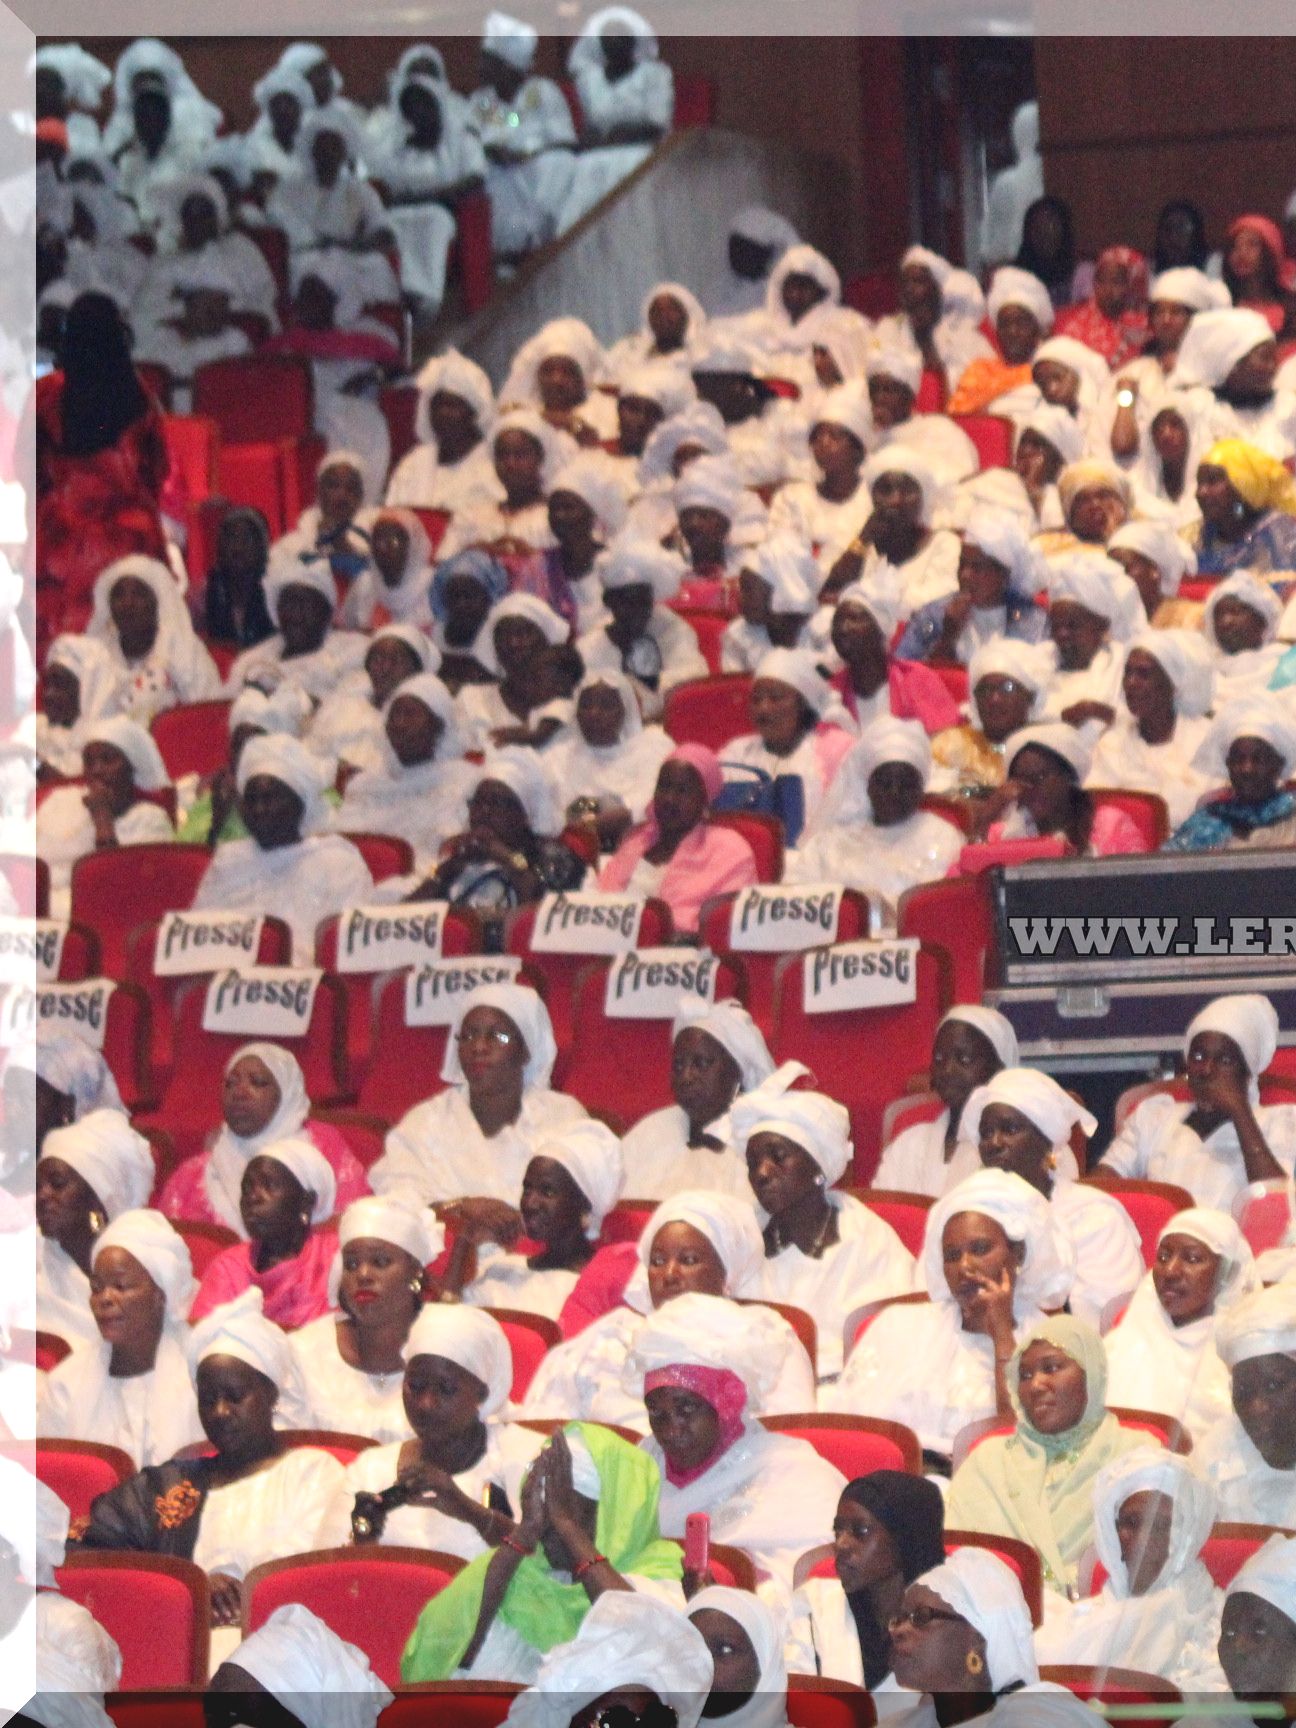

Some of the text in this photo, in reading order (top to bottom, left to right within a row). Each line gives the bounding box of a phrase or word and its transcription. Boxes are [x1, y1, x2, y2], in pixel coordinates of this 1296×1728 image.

[165, 907, 257, 959] Presse
[347, 909, 438, 954] Presse
[545, 893, 636, 938] Presse
[741, 890, 835, 931] Presse
[216, 967, 312, 1018] Presse
[616, 951, 714, 1000] Presse
[813, 949, 911, 996] Presse
